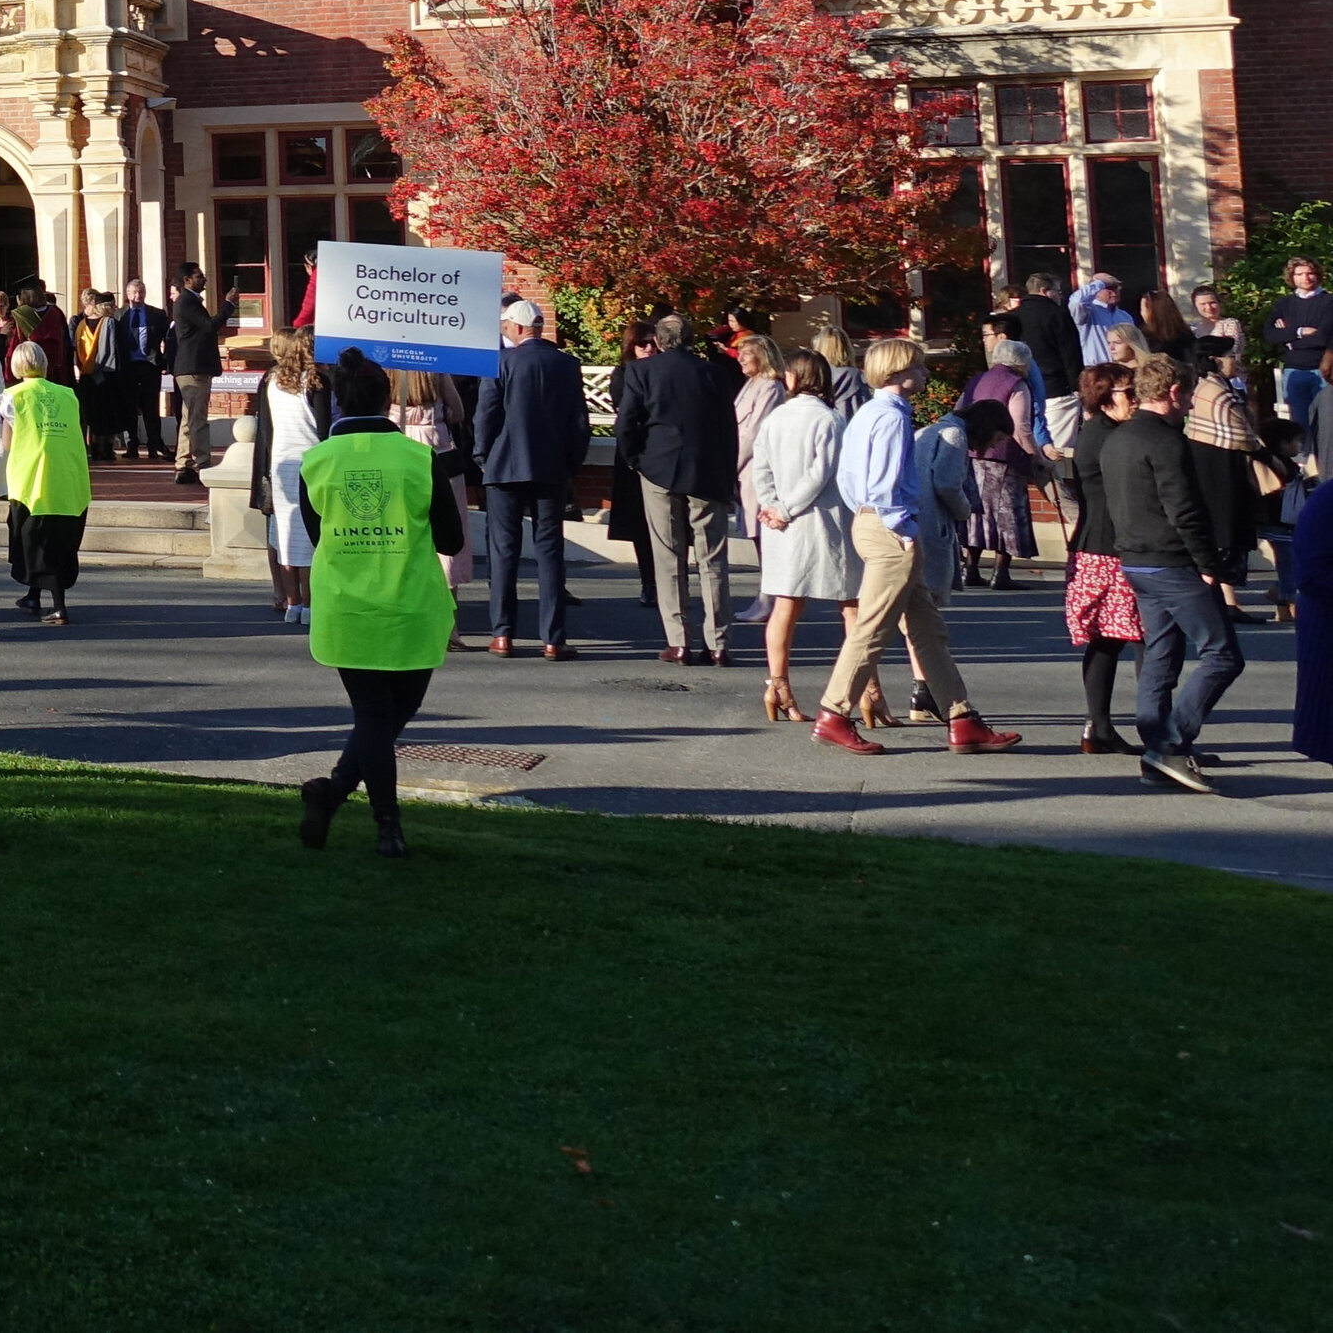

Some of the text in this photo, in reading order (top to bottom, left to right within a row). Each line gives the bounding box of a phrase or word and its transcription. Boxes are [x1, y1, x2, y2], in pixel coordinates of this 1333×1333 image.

[356, 264, 461, 285] Bachelor of
[356, 285, 458, 306] Commerce
[347, 303, 466, 330] (Agriculture)
[391, 353, 438, 362] UNIVERSITY
[211, 376, 242, 386] eaching
[243, 376, 259, 384] and
[36, 421, 68, 429] LINCOLN
[333, 527, 404, 537] LINCOLN
